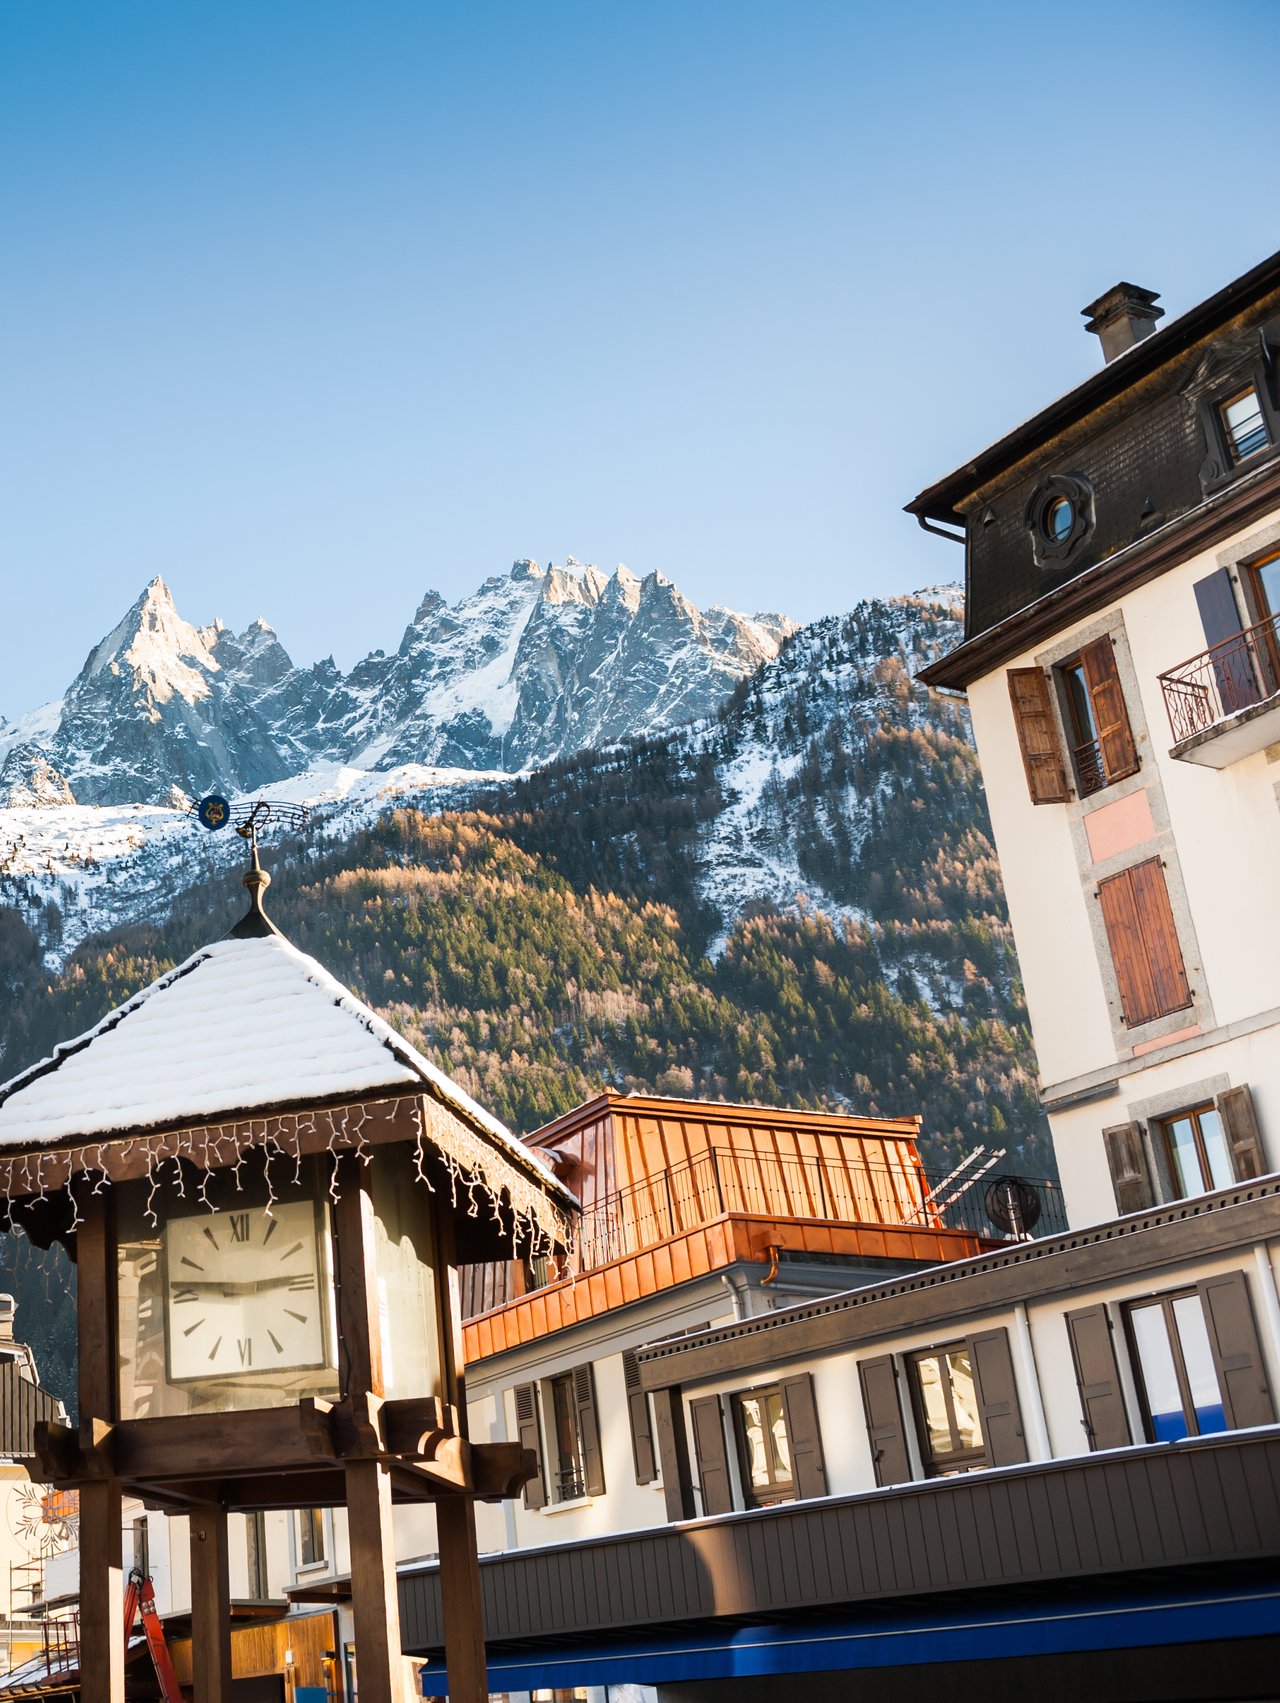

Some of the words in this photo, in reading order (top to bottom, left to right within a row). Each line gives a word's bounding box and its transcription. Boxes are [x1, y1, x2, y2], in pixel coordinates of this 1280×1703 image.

[229, 1213, 250, 1243] XII
[288, 1272, 315, 1292] III
[237, 1337, 252, 1367] VI
